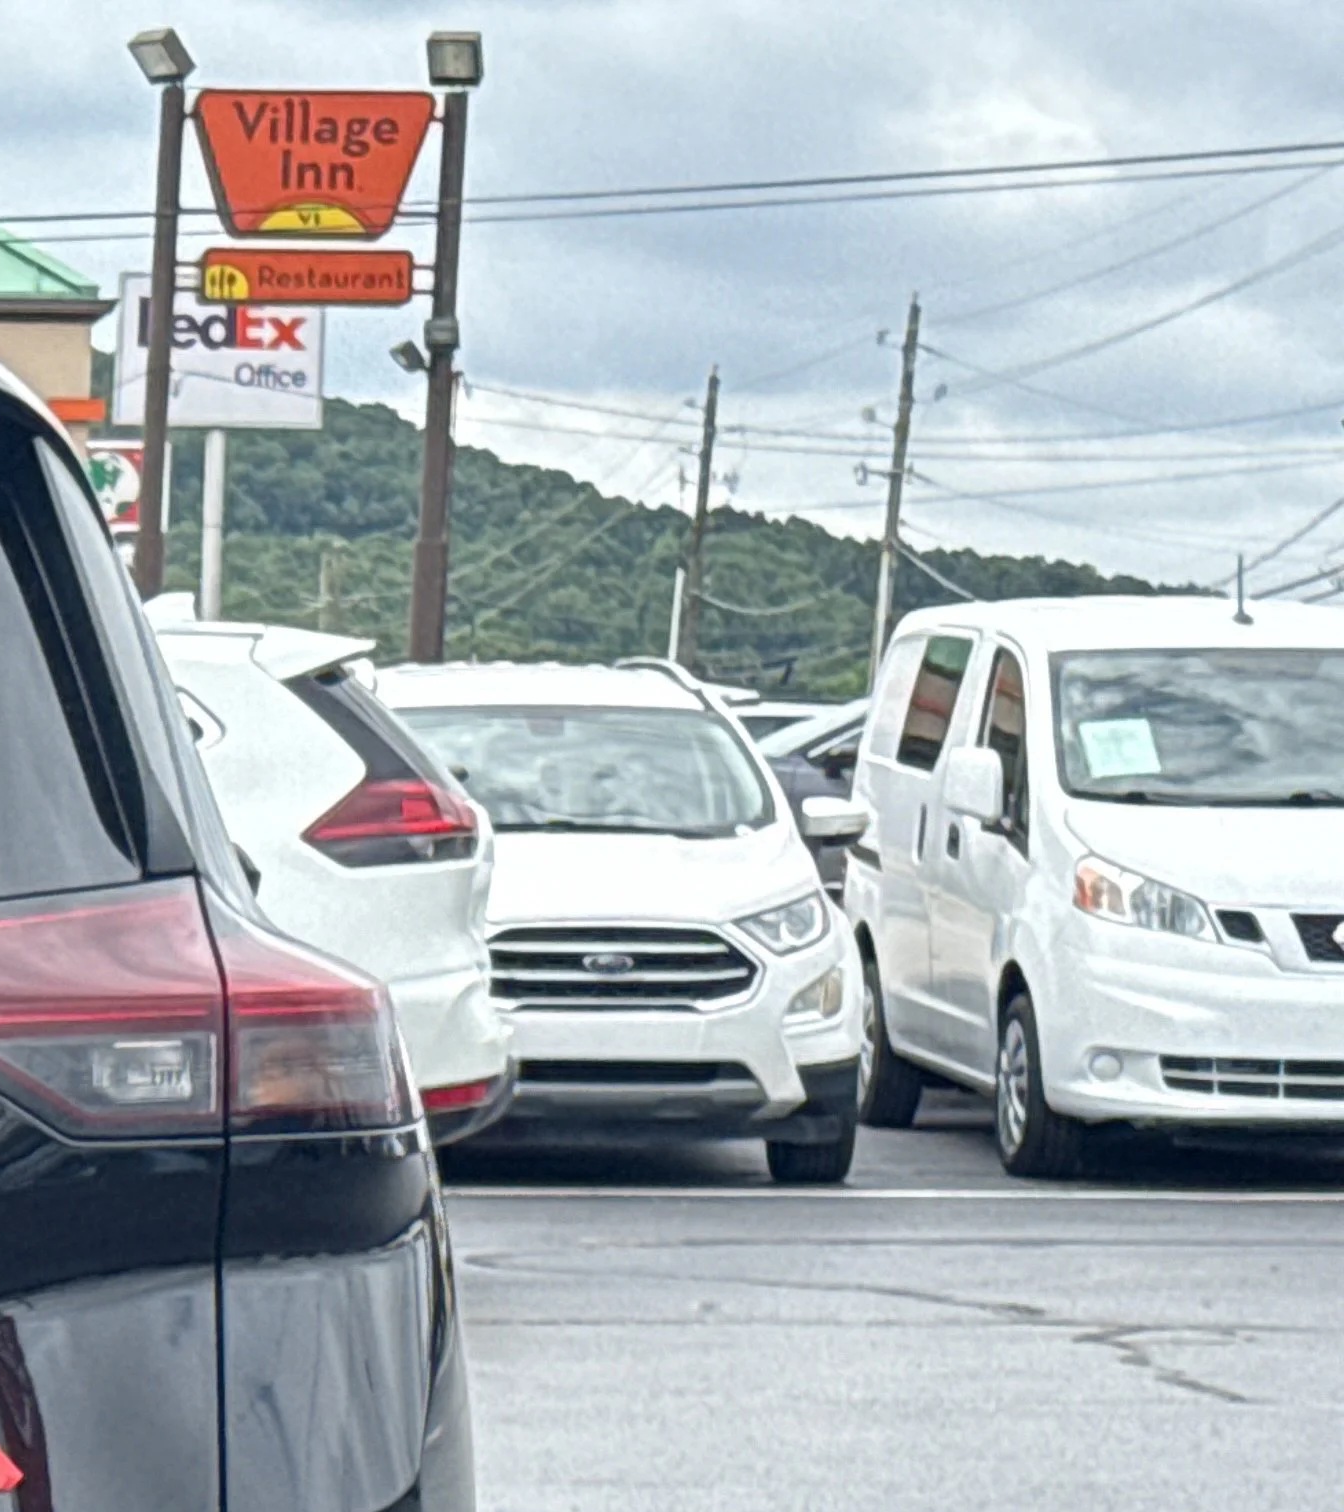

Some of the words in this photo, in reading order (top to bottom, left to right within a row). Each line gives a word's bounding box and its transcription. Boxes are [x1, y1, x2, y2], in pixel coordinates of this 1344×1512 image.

[232, 98, 399, 157] Village
[281, 149, 354, 190] Inn
[257, 264, 405, 290] Restaurant
[234, 362, 307, 388] Office
